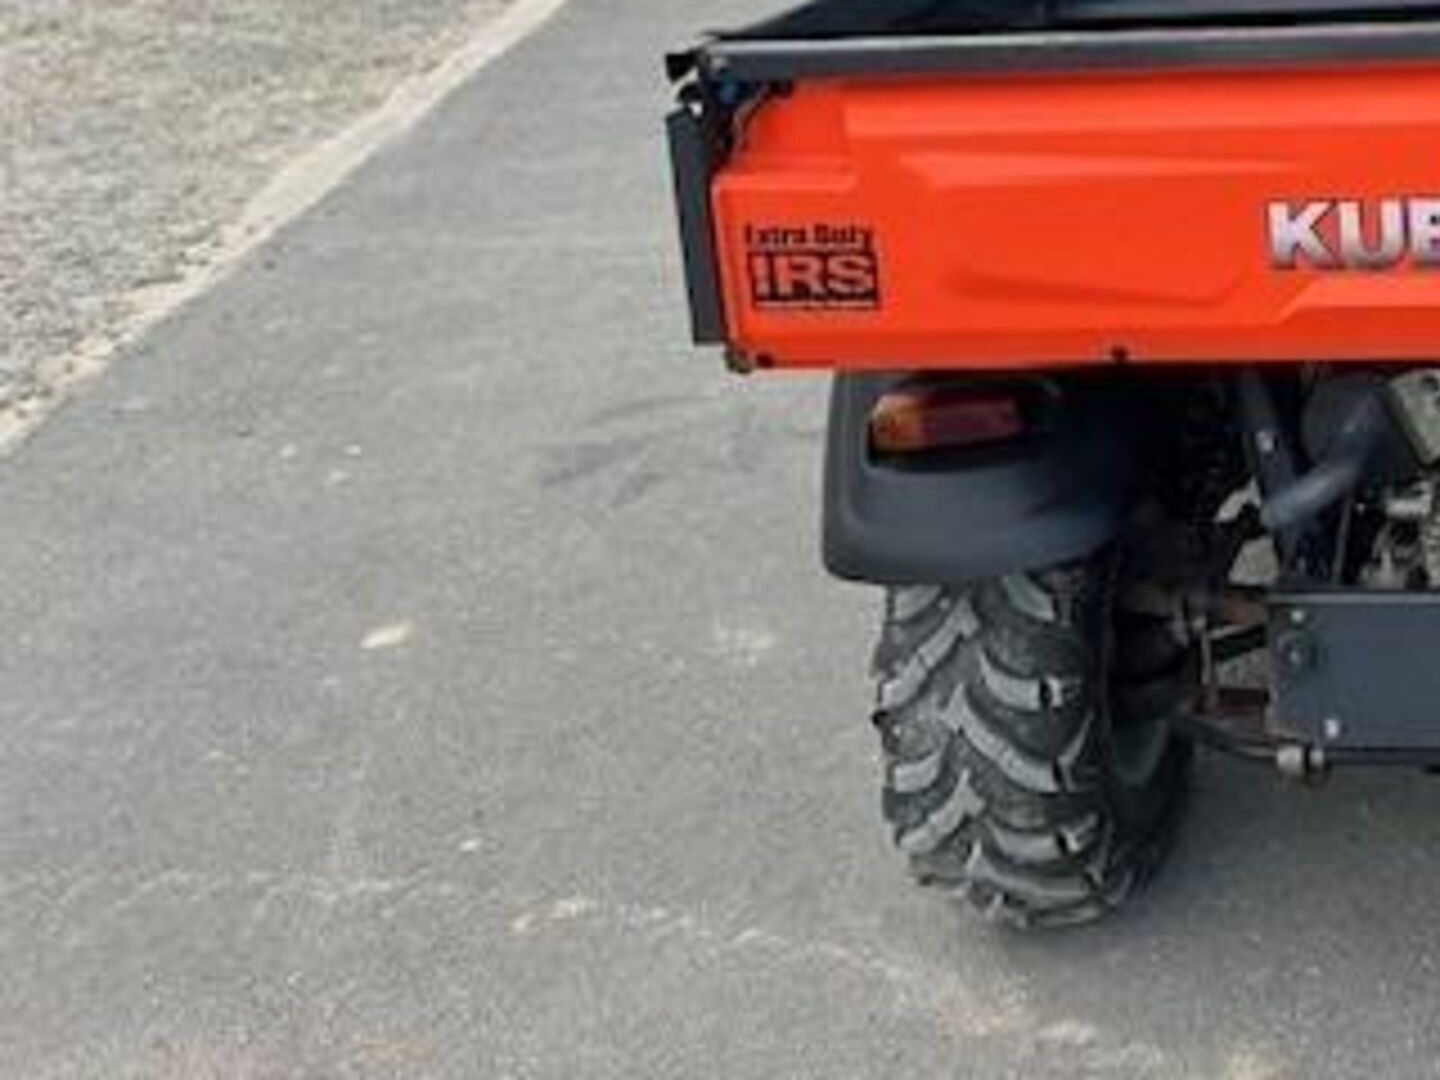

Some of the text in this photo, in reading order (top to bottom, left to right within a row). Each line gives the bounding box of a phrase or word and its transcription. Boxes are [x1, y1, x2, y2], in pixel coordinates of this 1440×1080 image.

[745, 223, 874, 252] Extra Duty
[752, 254, 876, 298] IRS
